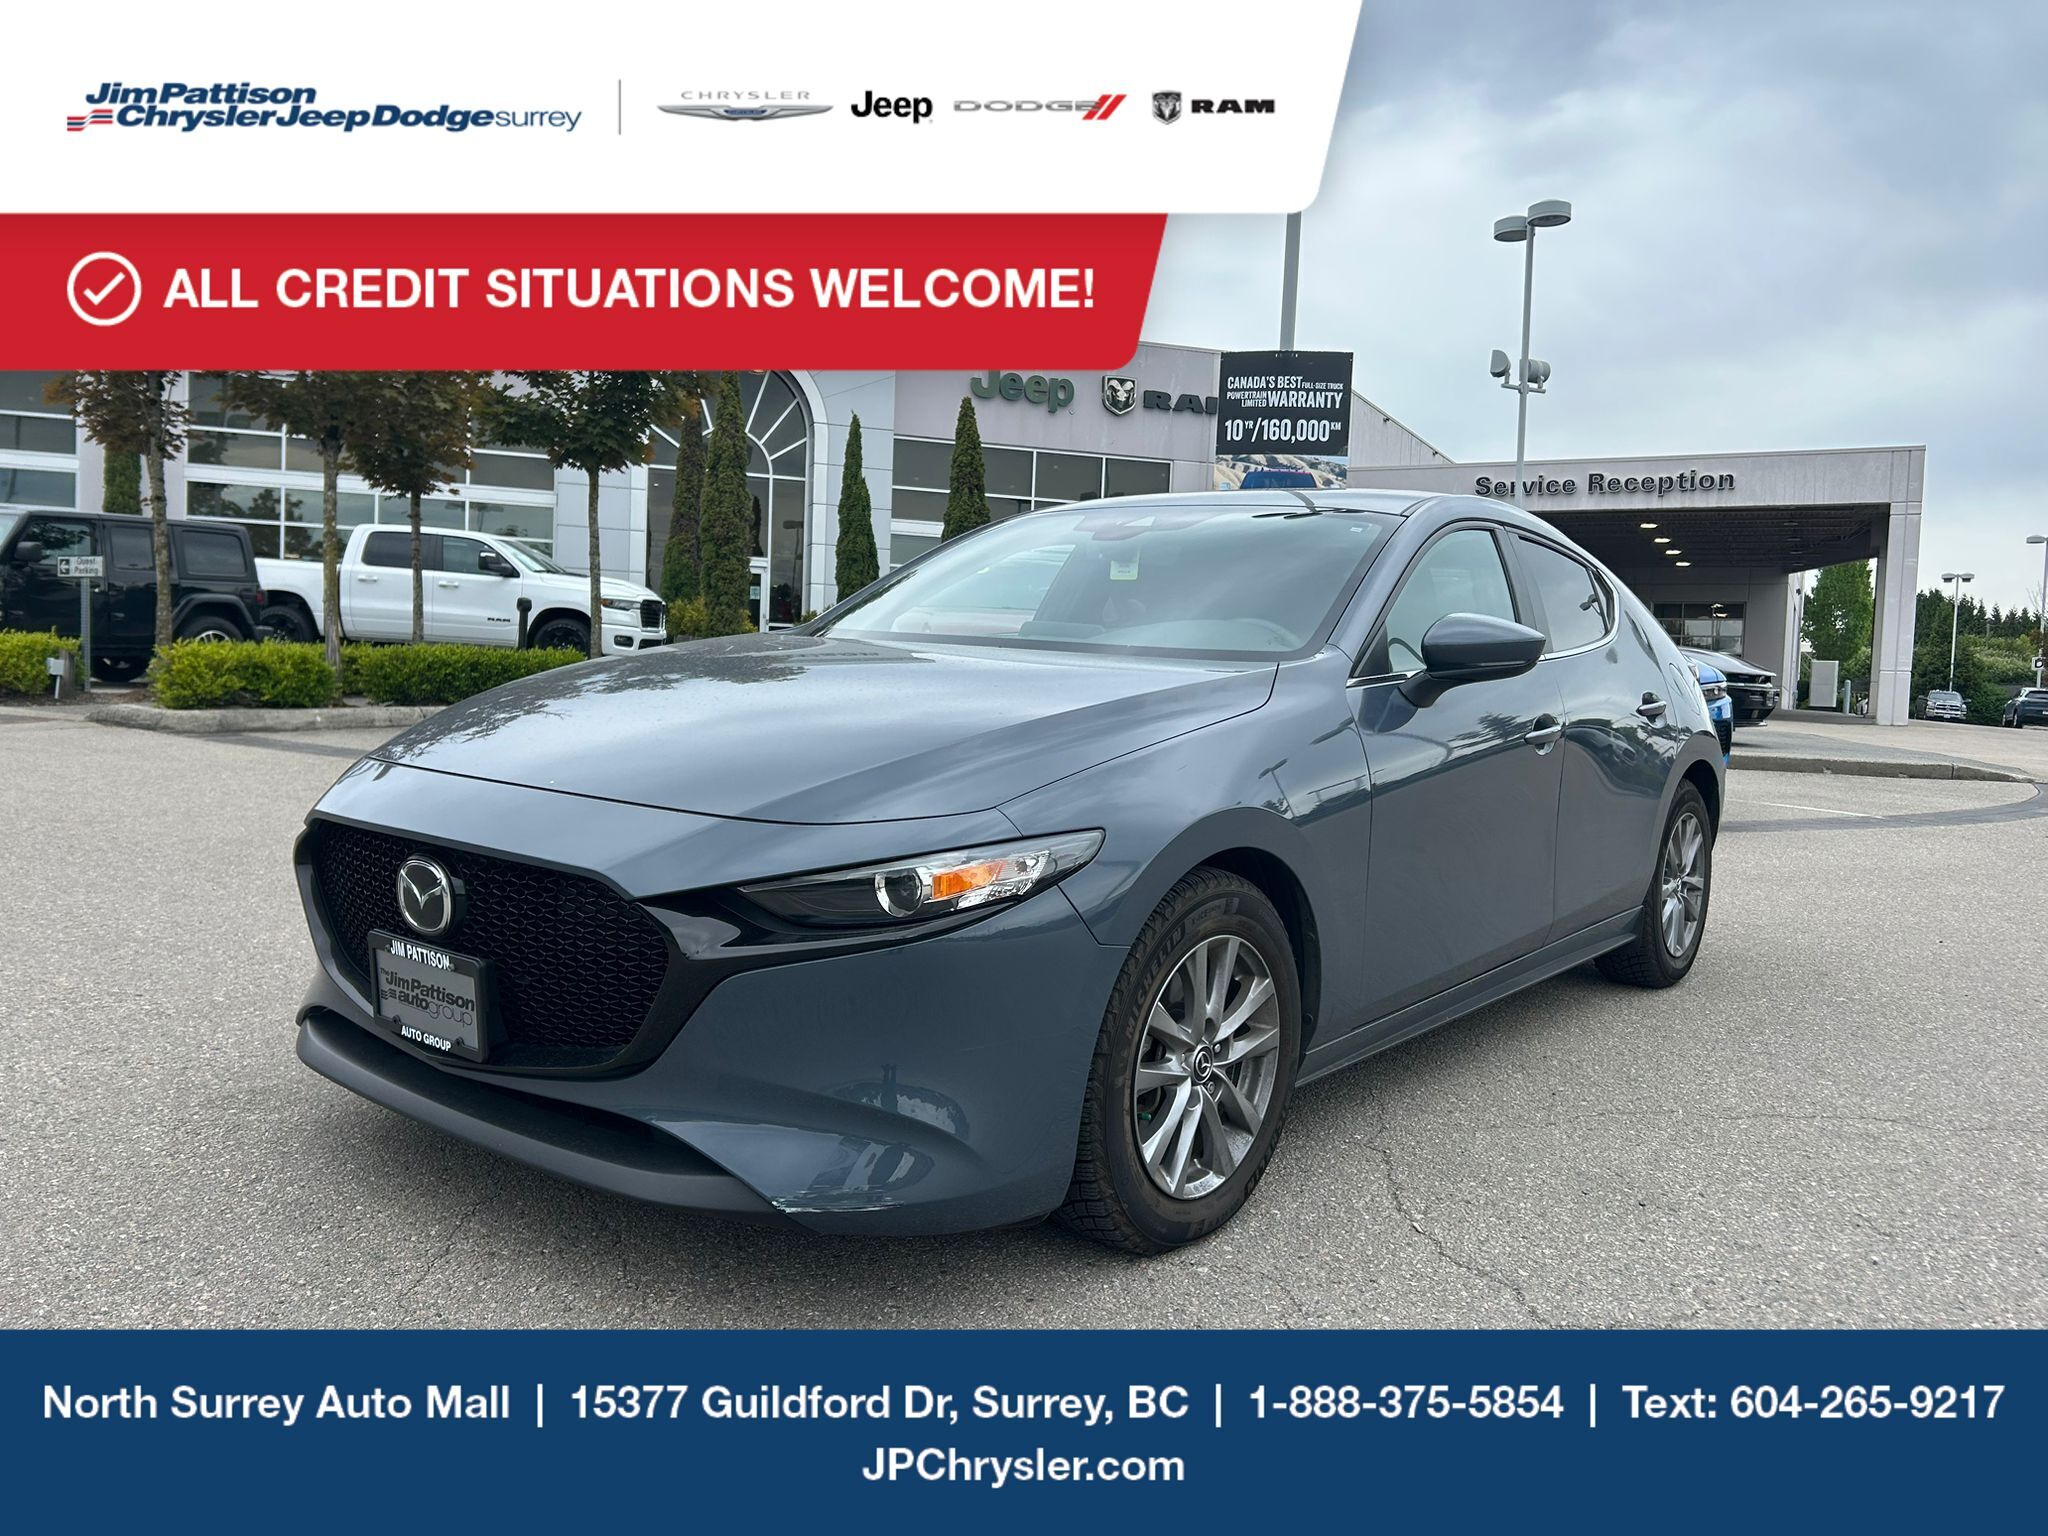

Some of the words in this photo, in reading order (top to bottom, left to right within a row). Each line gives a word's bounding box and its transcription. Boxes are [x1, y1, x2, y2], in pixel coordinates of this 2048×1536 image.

[970, 369, 1075, 414] Jeep
[1227, 376, 1276, 389] CANADA'S
[1277, 375, 1303, 389] BEST
[1327, 382, 1344, 390] TRUCK
[1226, 391, 1267, 400] POWERTRAIN
[1267, 391, 1343, 409] WARRANTY
[1241, 399, 1267, 408] LIMITED
[1587, 469, 1735, 496] Reception
[390, 939, 406, 959] JIM
[406, 944, 451, 971] PATTISON
[401, 1025, 422, 1042] AUTO
[423, 1033, 452, 1052] GROUP
